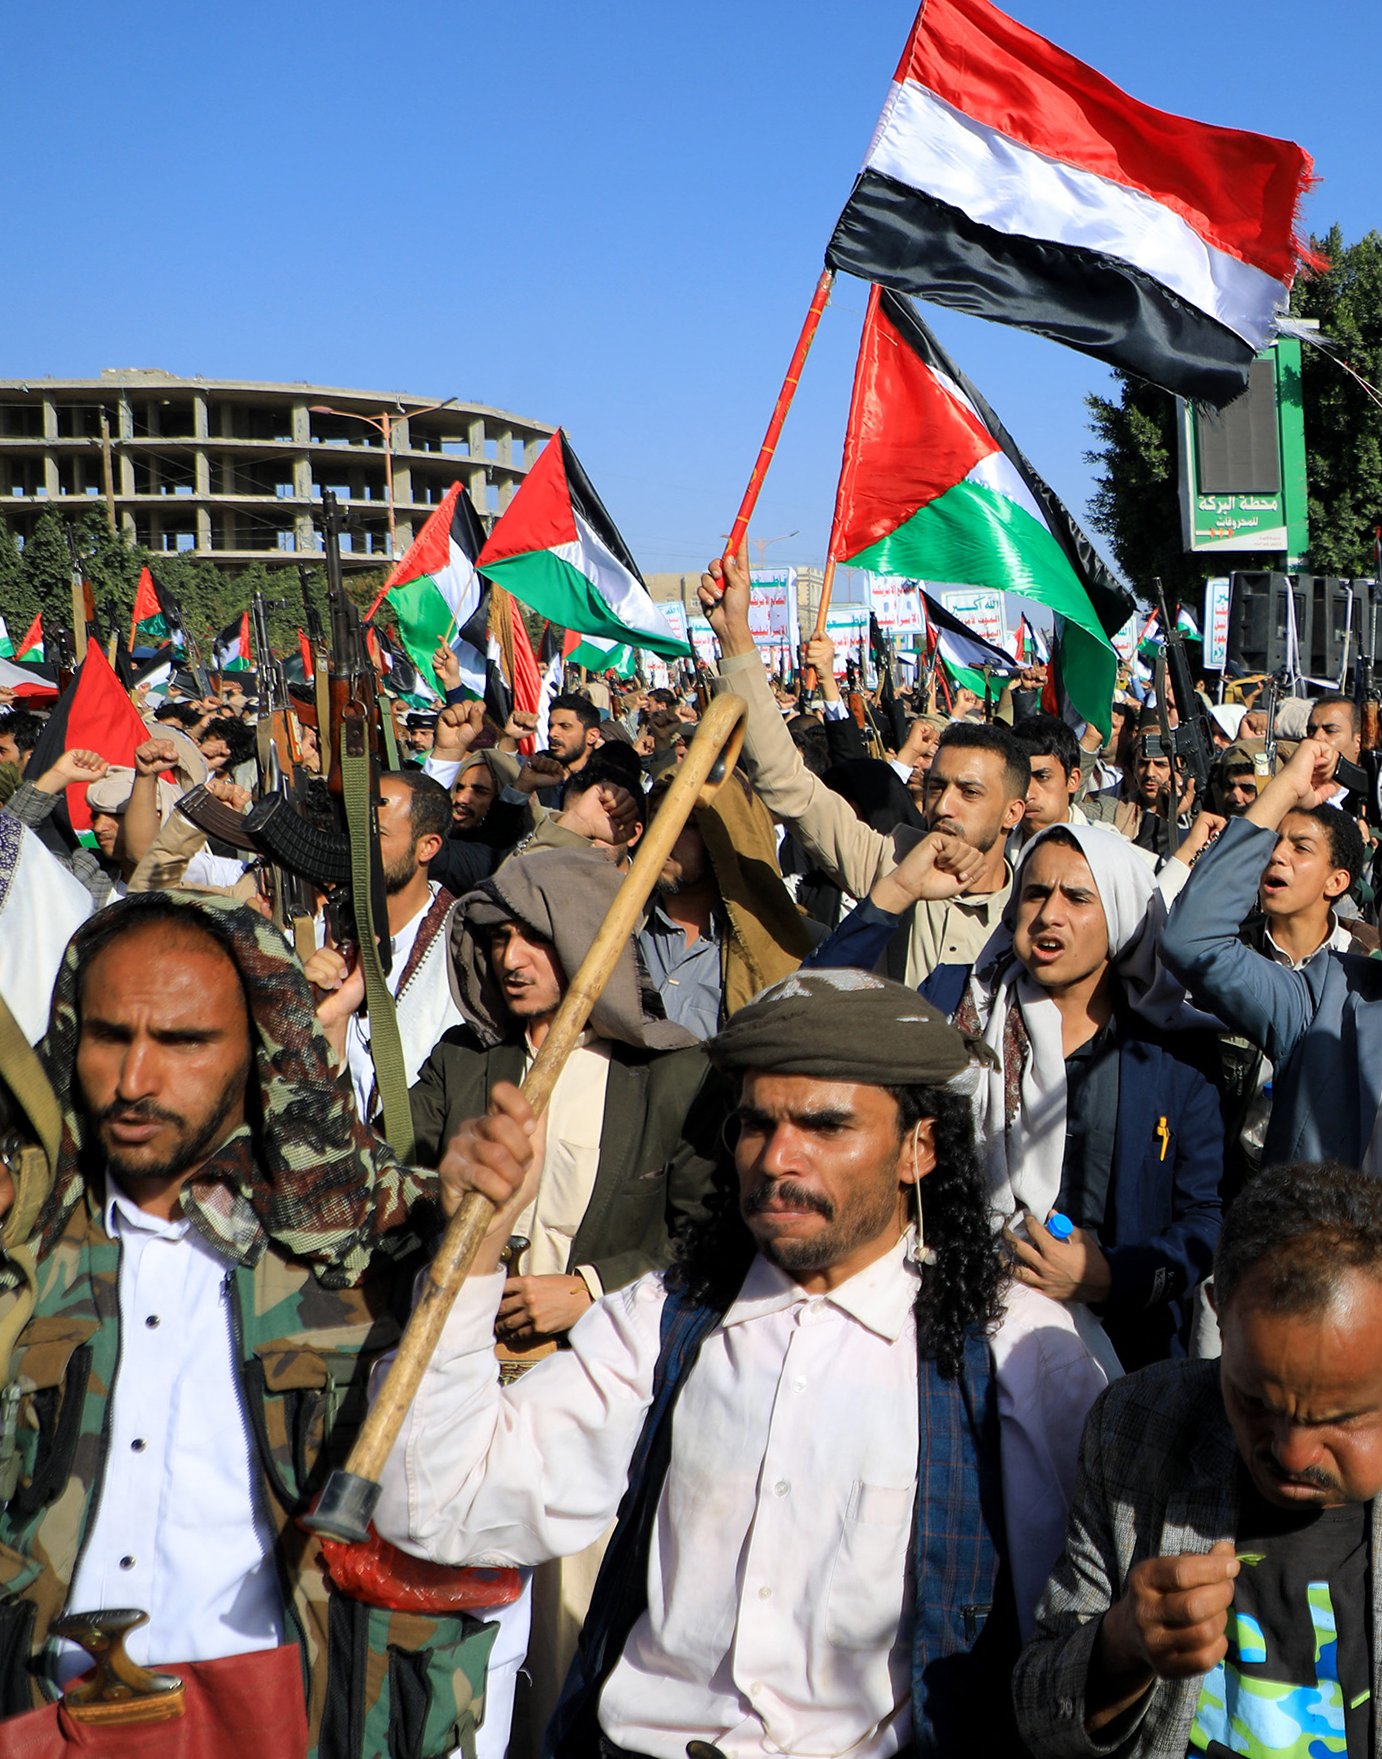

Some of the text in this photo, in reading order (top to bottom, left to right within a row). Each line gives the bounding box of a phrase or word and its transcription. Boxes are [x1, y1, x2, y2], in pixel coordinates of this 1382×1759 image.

[1198, 495, 1278, 515] محطة البركة
[1216, 517, 1258, 530] للمحروقات
[985, 596, 999, 609] الله
